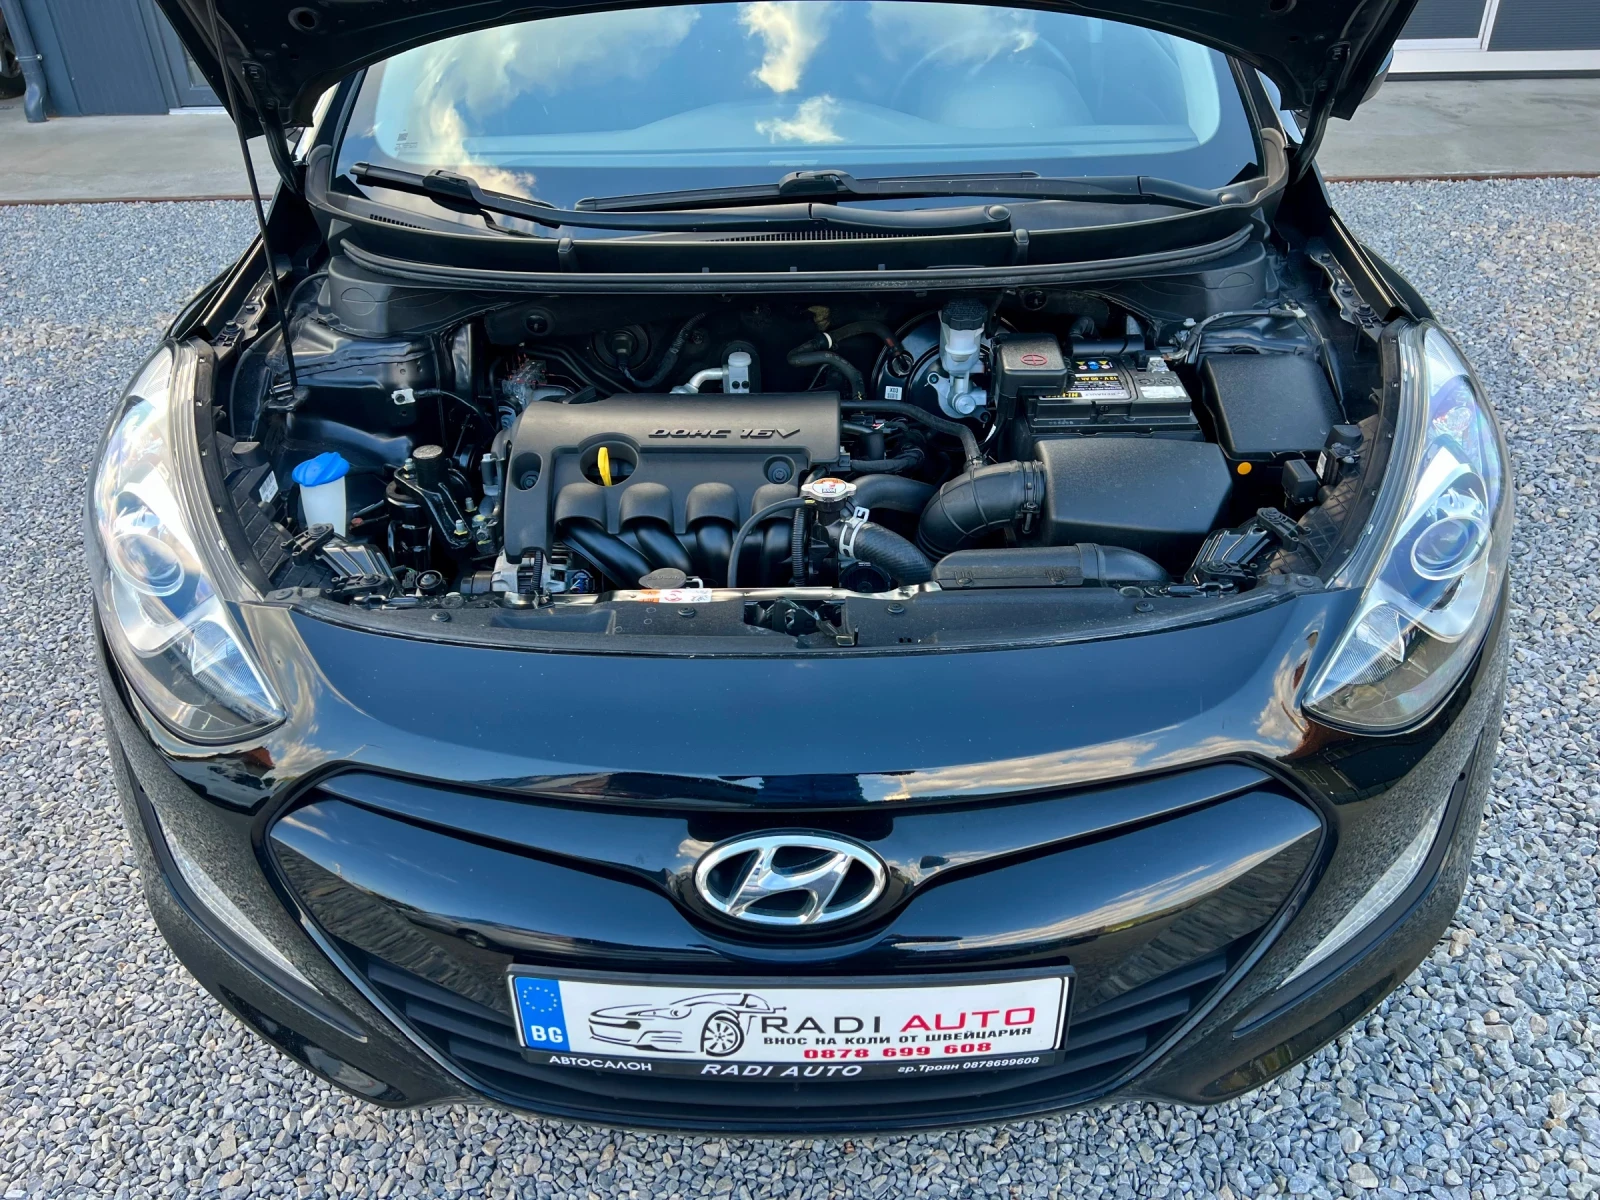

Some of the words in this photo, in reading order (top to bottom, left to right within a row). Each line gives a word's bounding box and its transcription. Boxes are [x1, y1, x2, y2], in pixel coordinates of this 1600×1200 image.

[648, 428, 732, 439] DOHC
[739, 428, 801, 439] 16V
[761, 1016, 881, 1034] RADI
[900, 1007, 1036, 1032] AUTO
[531, 1025, 563, 1043] BG
[763, 1037, 807, 1045] ВНОС
[815, 1037, 837, 1045] НА
[845, 1036, 891, 1045] КОЛИ
[899, 1035, 919, 1043] ОТ
[926, 1027, 1032, 1042] ШВЕЙЦАРИЯ
[804, 1048, 869, 1059] 0878
[882, 1046, 931, 1057] 699
[944, 1042, 992, 1054] 608
[549, 1055, 652, 1071] АВТОСАЛОН
[701, 1064, 773, 1077] RADI
[780, 1065, 862, 1077] AUTO
[962, 1056, 1040, 1069] 0878699608
